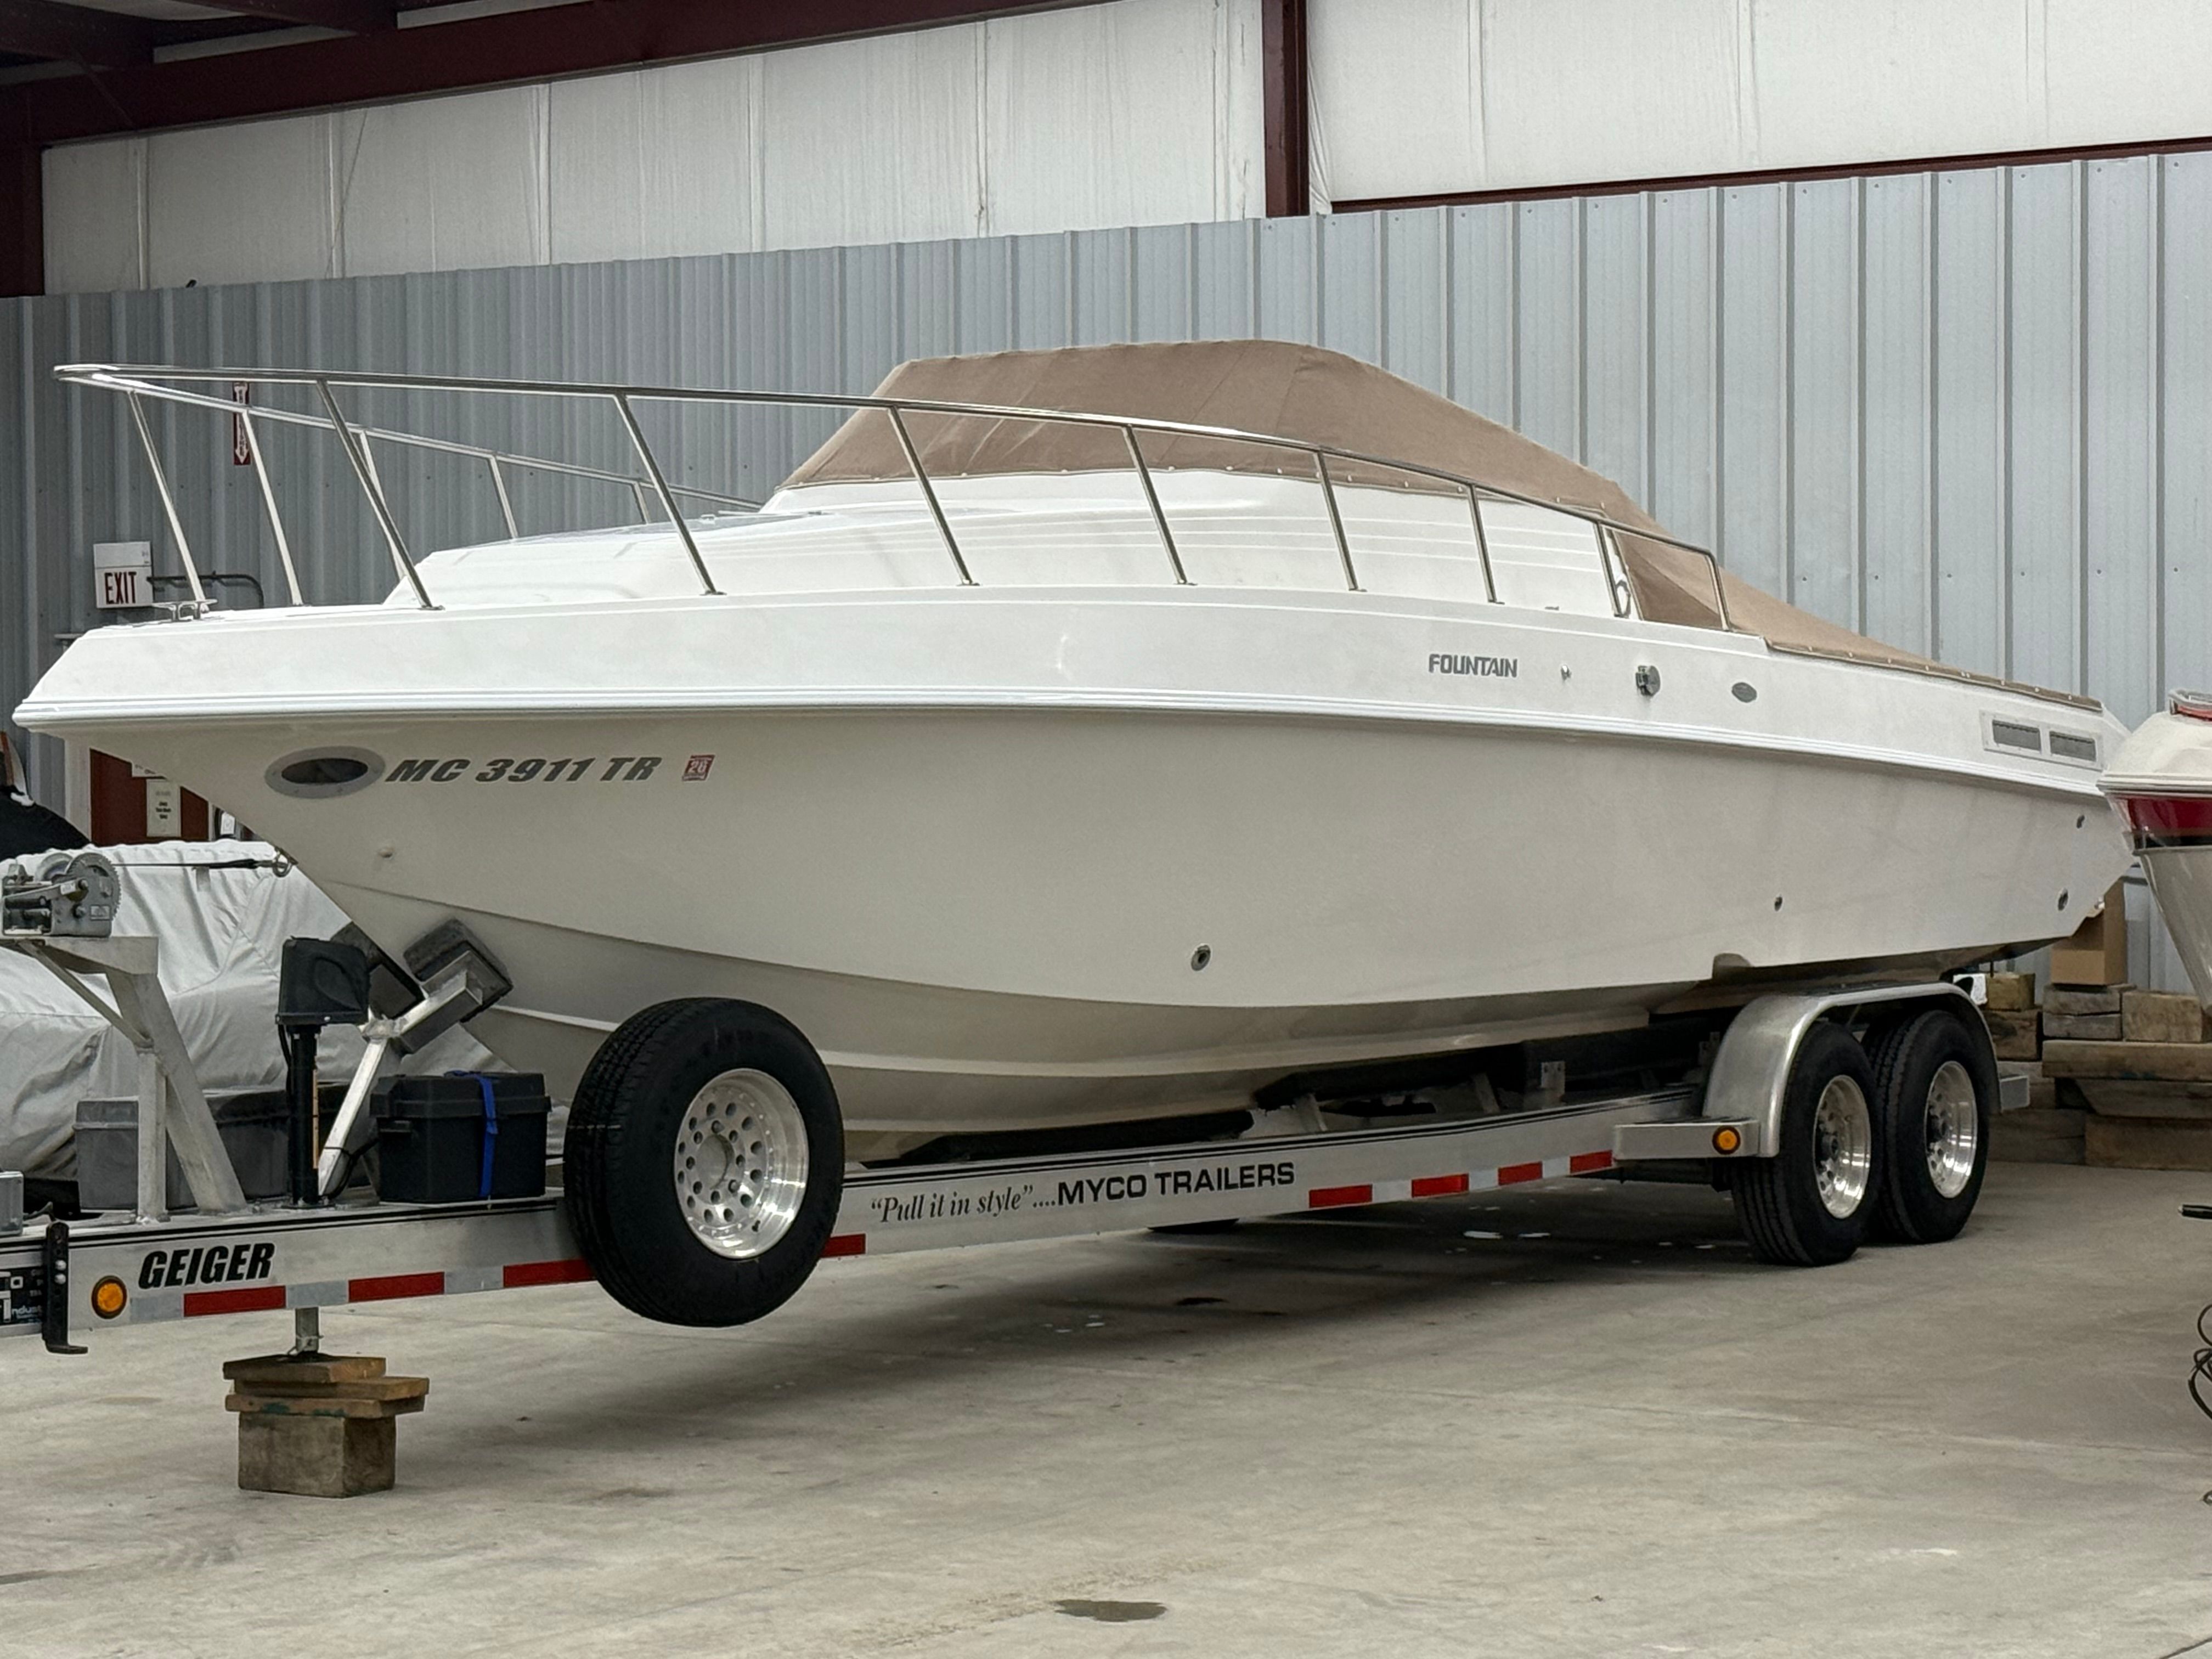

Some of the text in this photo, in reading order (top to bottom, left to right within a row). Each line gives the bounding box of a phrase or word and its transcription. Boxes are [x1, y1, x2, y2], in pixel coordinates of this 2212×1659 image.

[104, 572, 137, 605] EXIT
[1428, 653, 1517, 678] FOUNTAIN
[385, 757, 663, 782] MC 3911 TR
[871, 1193, 926, 1223] “Pull
[930, 1192, 945, 1218] it
[950, 1191, 970, 1216] in
[1058, 1174, 1147, 1206] MYCO
[1154, 1162, 1295, 1195] TRAILERS
[138, 1243, 275, 1289] GEIGER
